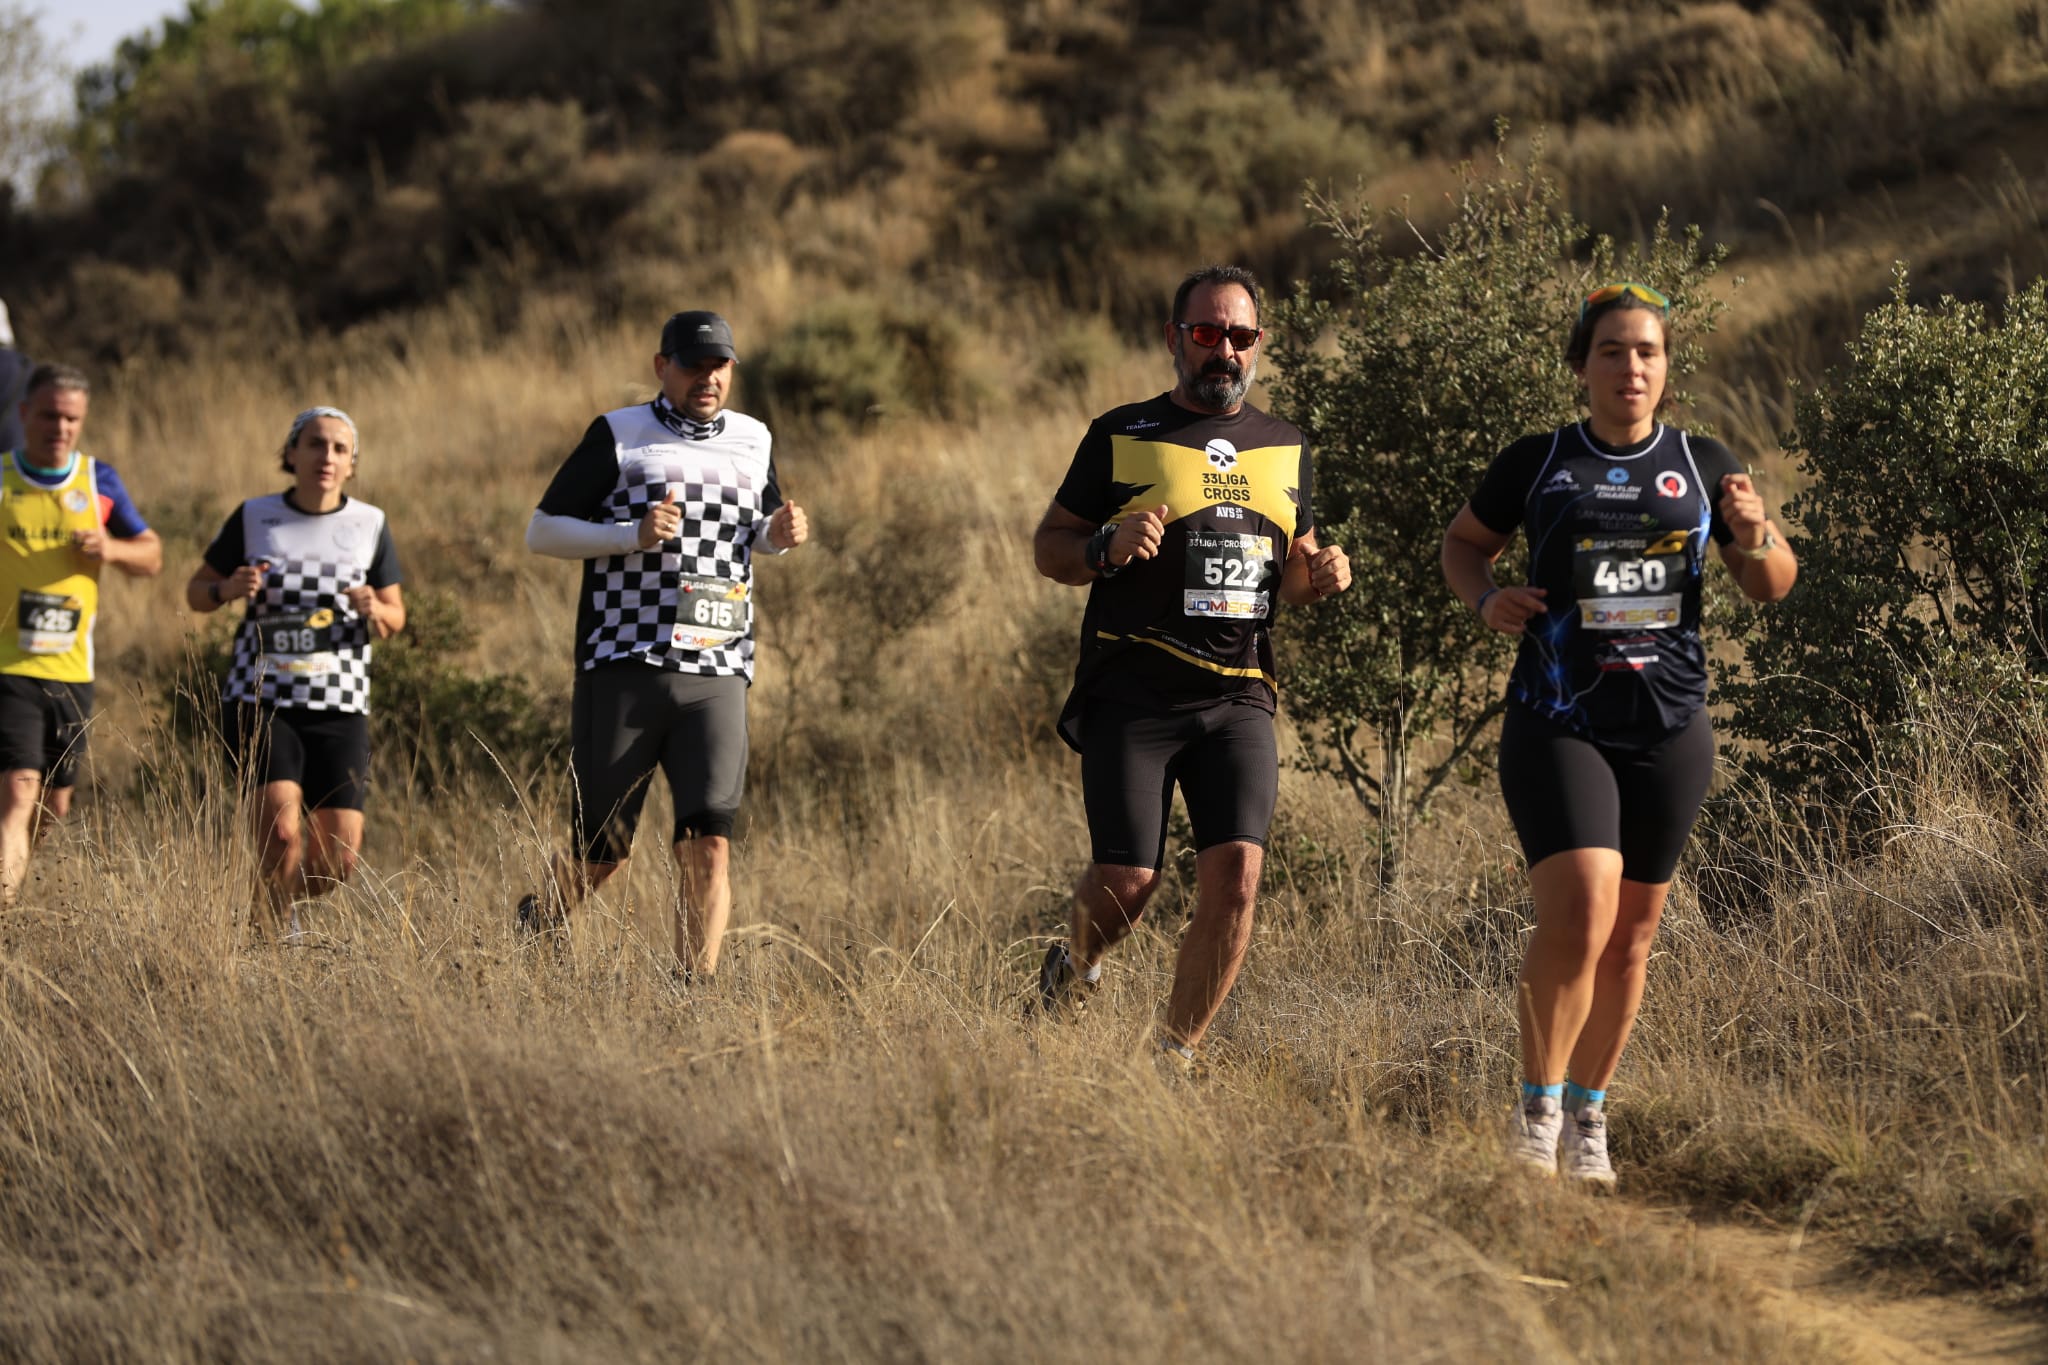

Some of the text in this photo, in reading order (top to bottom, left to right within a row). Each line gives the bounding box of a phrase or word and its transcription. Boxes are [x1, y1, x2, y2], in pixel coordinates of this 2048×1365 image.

[1201, 472, 1249, 486] 33LIGA
[1203, 487, 1251, 502] CROSS
[1216, 506, 1236, 519] AVS
[1224, 539, 1250, 549] CROSS
[1204, 557, 1259, 588] 522
[1593, 559, 1667, 594] 450
[28, 608, 73, 632] 425
[694, 598, 733, 627] 615
[1585, 608, 1677, 623] OMISAG
[273, 628, 315, 652] 618
